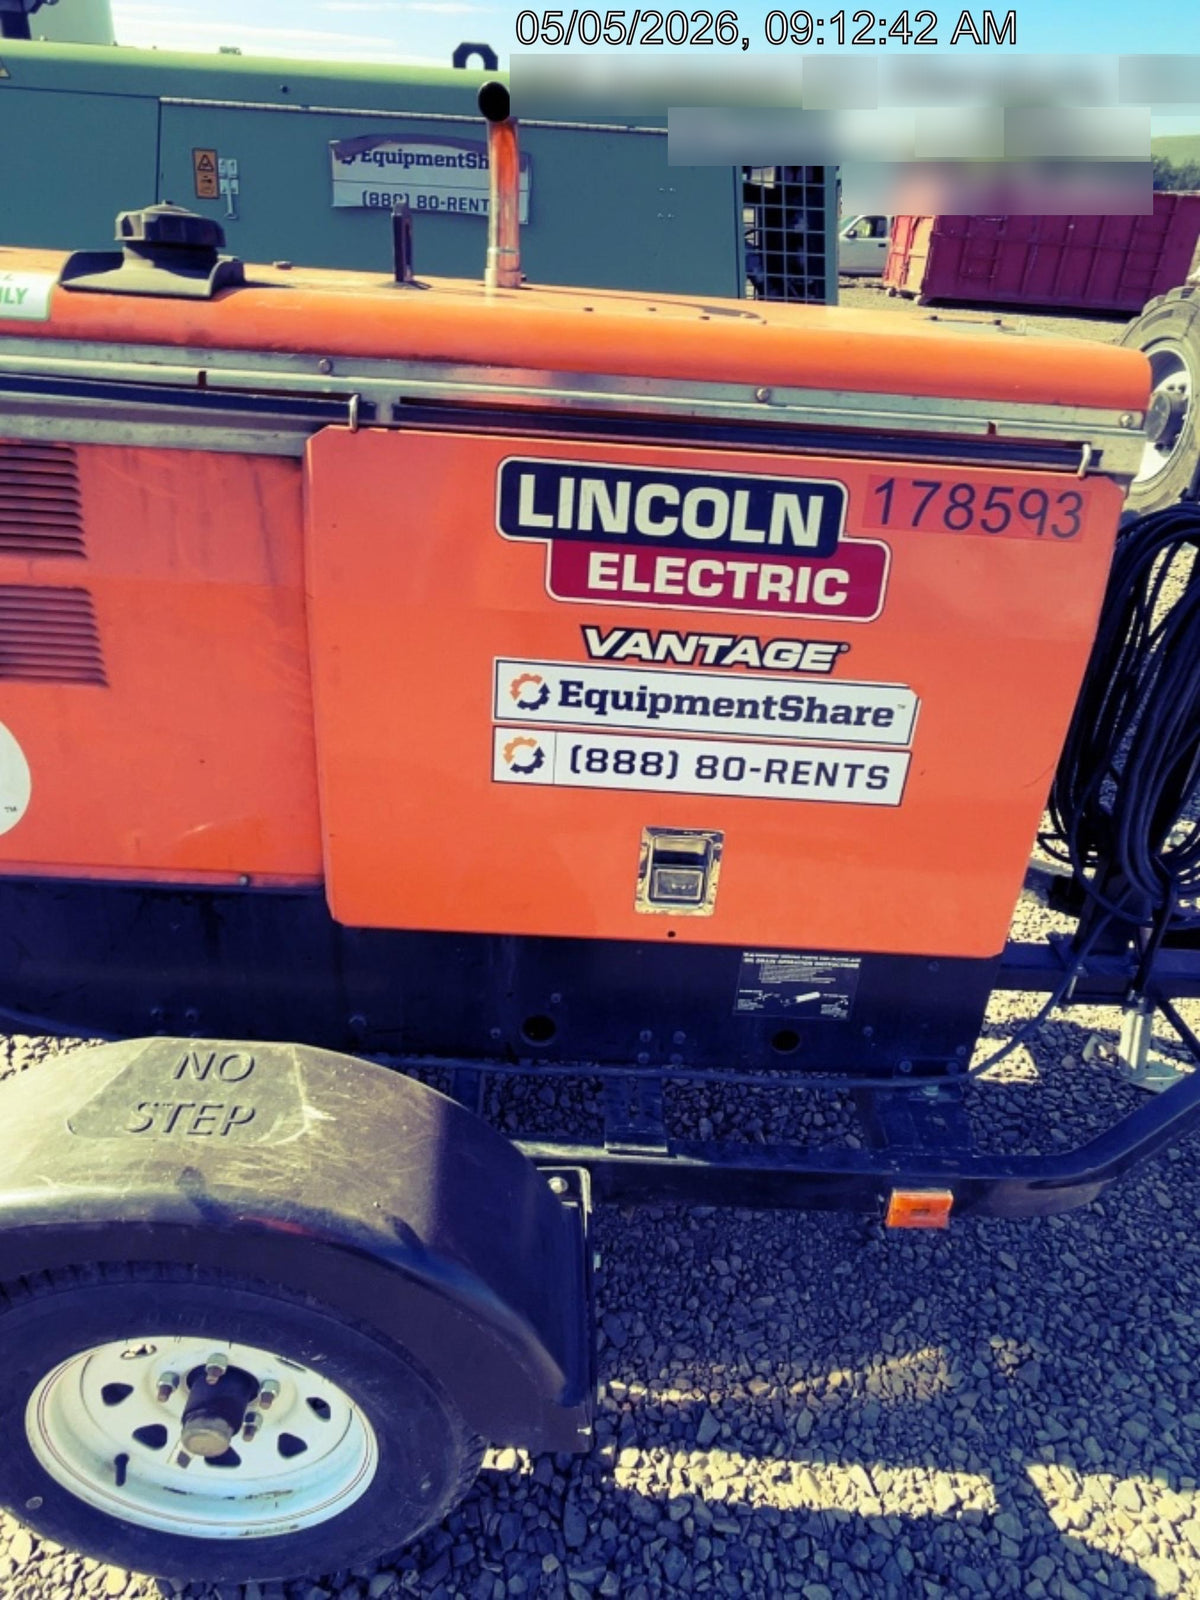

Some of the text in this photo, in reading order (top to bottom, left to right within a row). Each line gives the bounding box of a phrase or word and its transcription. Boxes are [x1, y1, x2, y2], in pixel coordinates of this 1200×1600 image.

[361, 149, 489, 169] EquipmentSh
[417, 195, 489, 212] 80-RENT
[518, 474, 825, 548] LINCOLN
[874, 478, 1083, 539] 178593
[587, 552, 850, 606] ELECTRIC
[581, 626, 850, 673] VANTAGE
[558, 680, 895, 728] EquipmentShare
[570, 744, 891, 791] (888) 80-RENTS
[173, 1052, 255, 1083] NO
[126, 1102, 256, 1137] STEP
